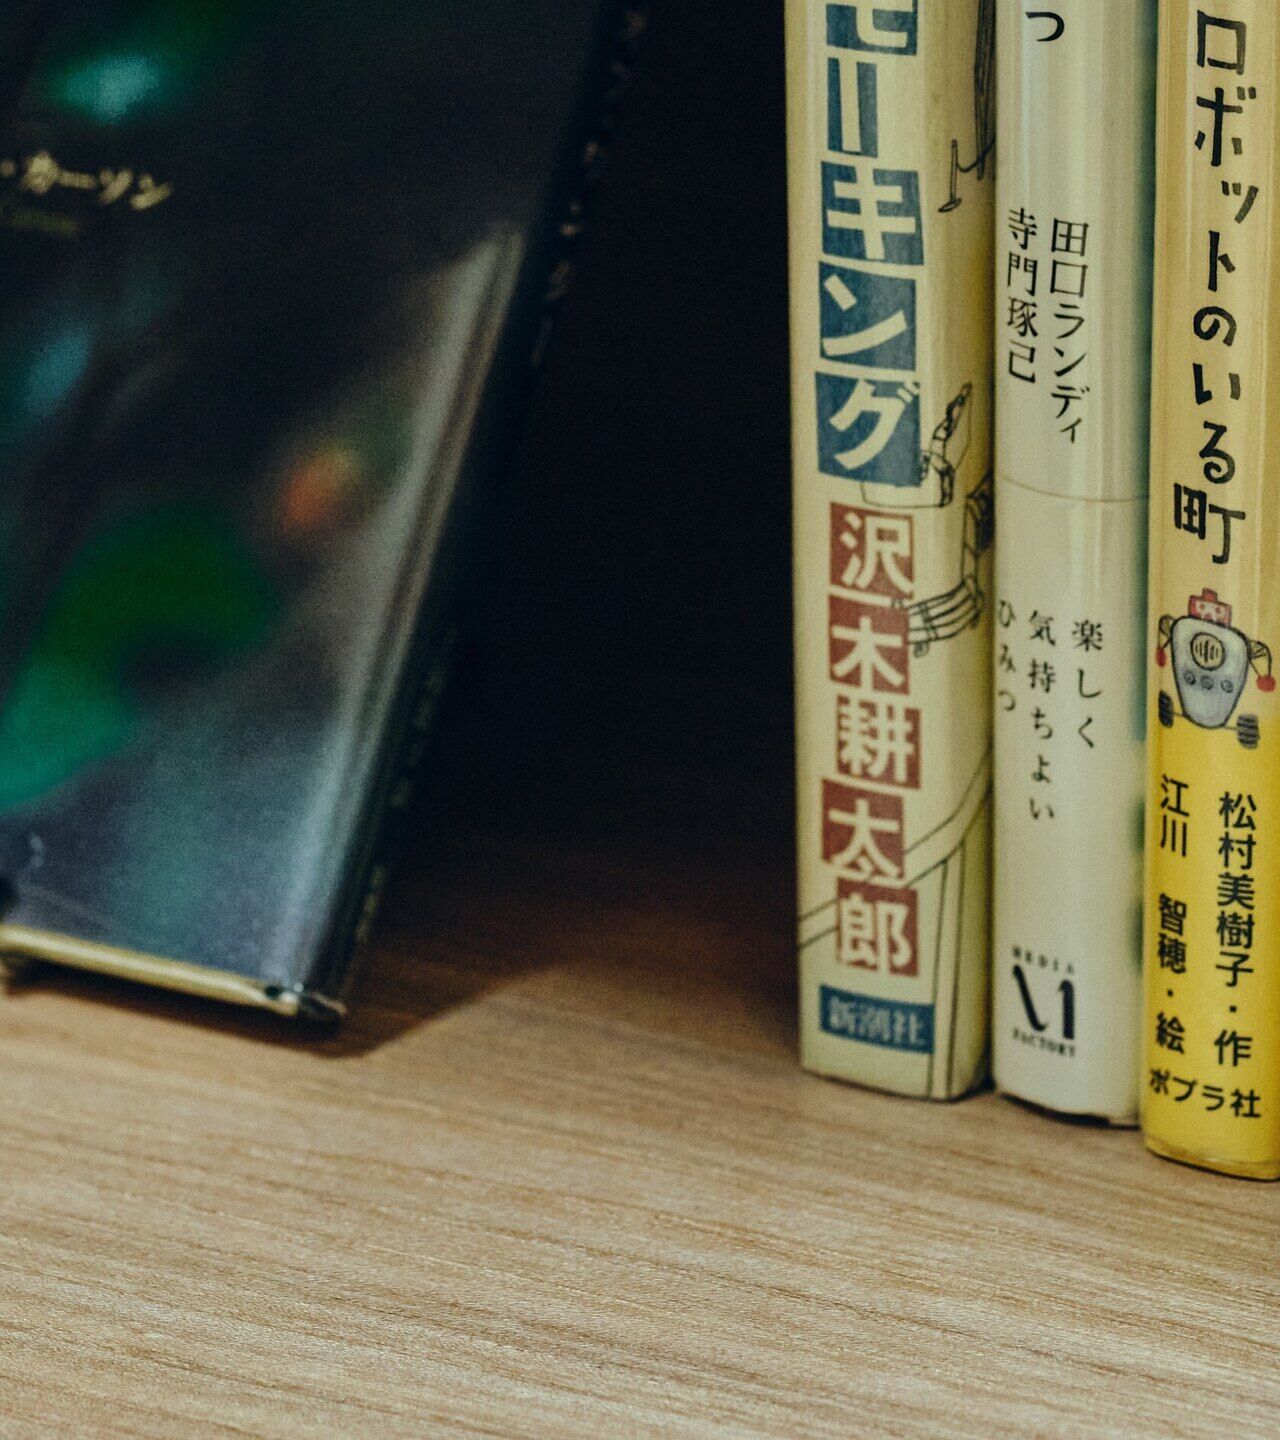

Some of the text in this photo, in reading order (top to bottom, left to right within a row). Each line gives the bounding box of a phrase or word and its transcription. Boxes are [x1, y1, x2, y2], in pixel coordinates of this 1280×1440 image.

[1006, 207, 1039, 384] 寺門琢己
[1050, 217, 1091, 444] 田口ランディ
[826, 508, 919, 974] 沢木耕太郎
[998, 599, 1017, 712] ひみつ
[1027, 610, 1058, 820] 気持ちよい
[1072, 618, 1104, 749] 楽しく
[1156, 774, 1190, 1055] 江川 智穂・絵
[1215, 793, 1256, 1066] 松村美樹子・作
[1150, 1068, 1262, 1118] ポプラ社
